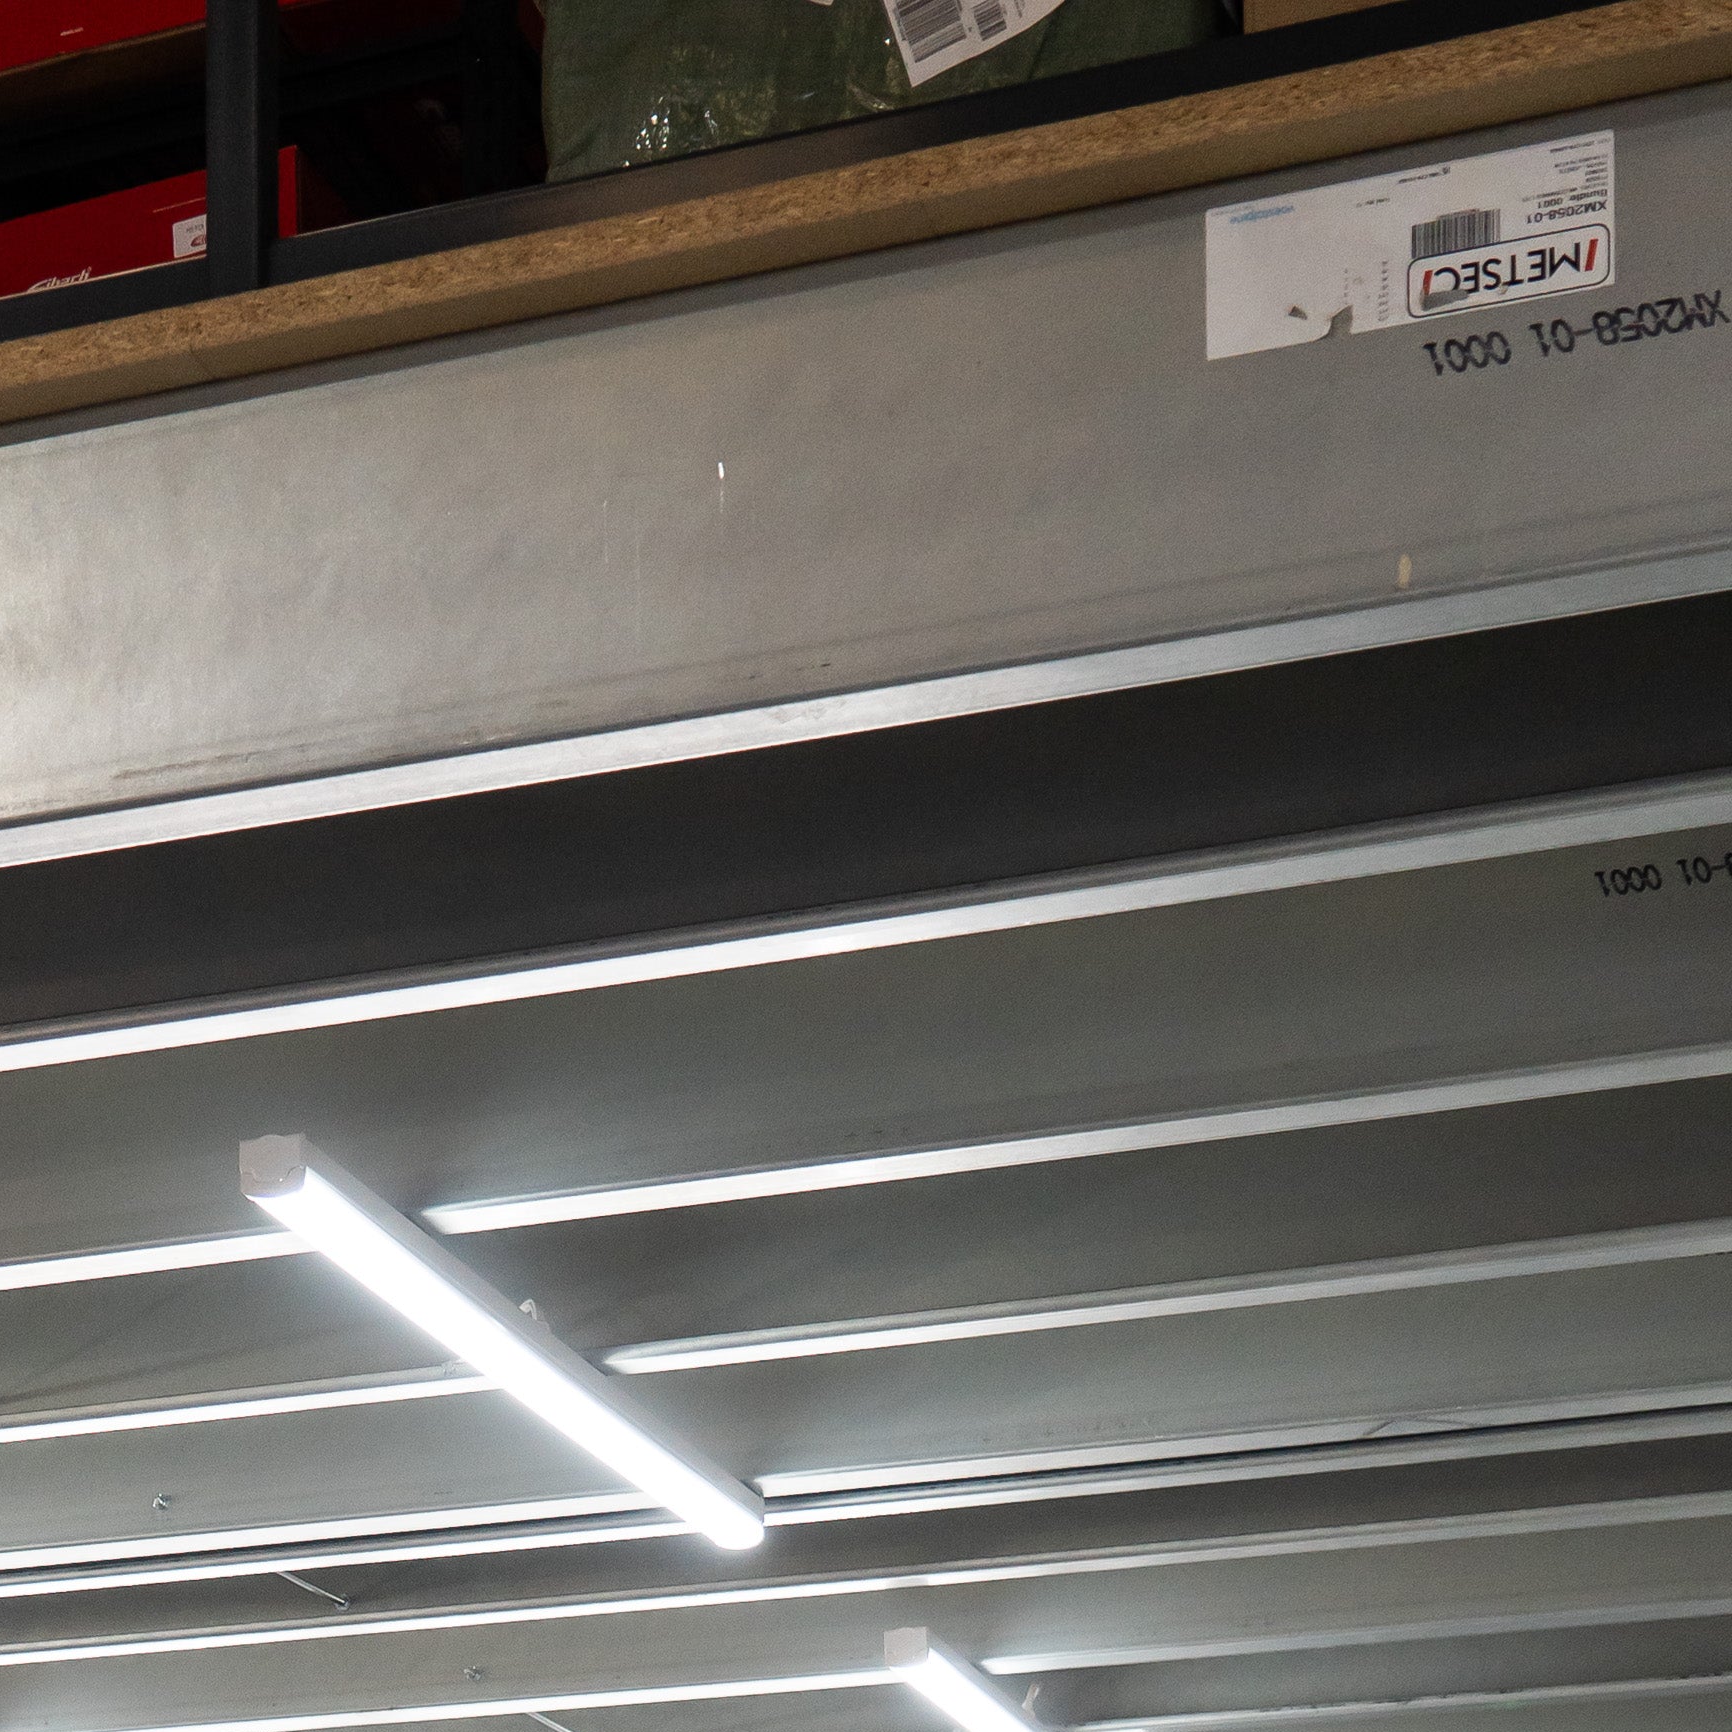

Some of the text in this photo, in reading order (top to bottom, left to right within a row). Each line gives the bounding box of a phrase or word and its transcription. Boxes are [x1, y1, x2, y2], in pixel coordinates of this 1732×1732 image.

[1422, 288, 1731, 376] XM2058-01 0001
[1594, 863, 1662, 898] 0001
